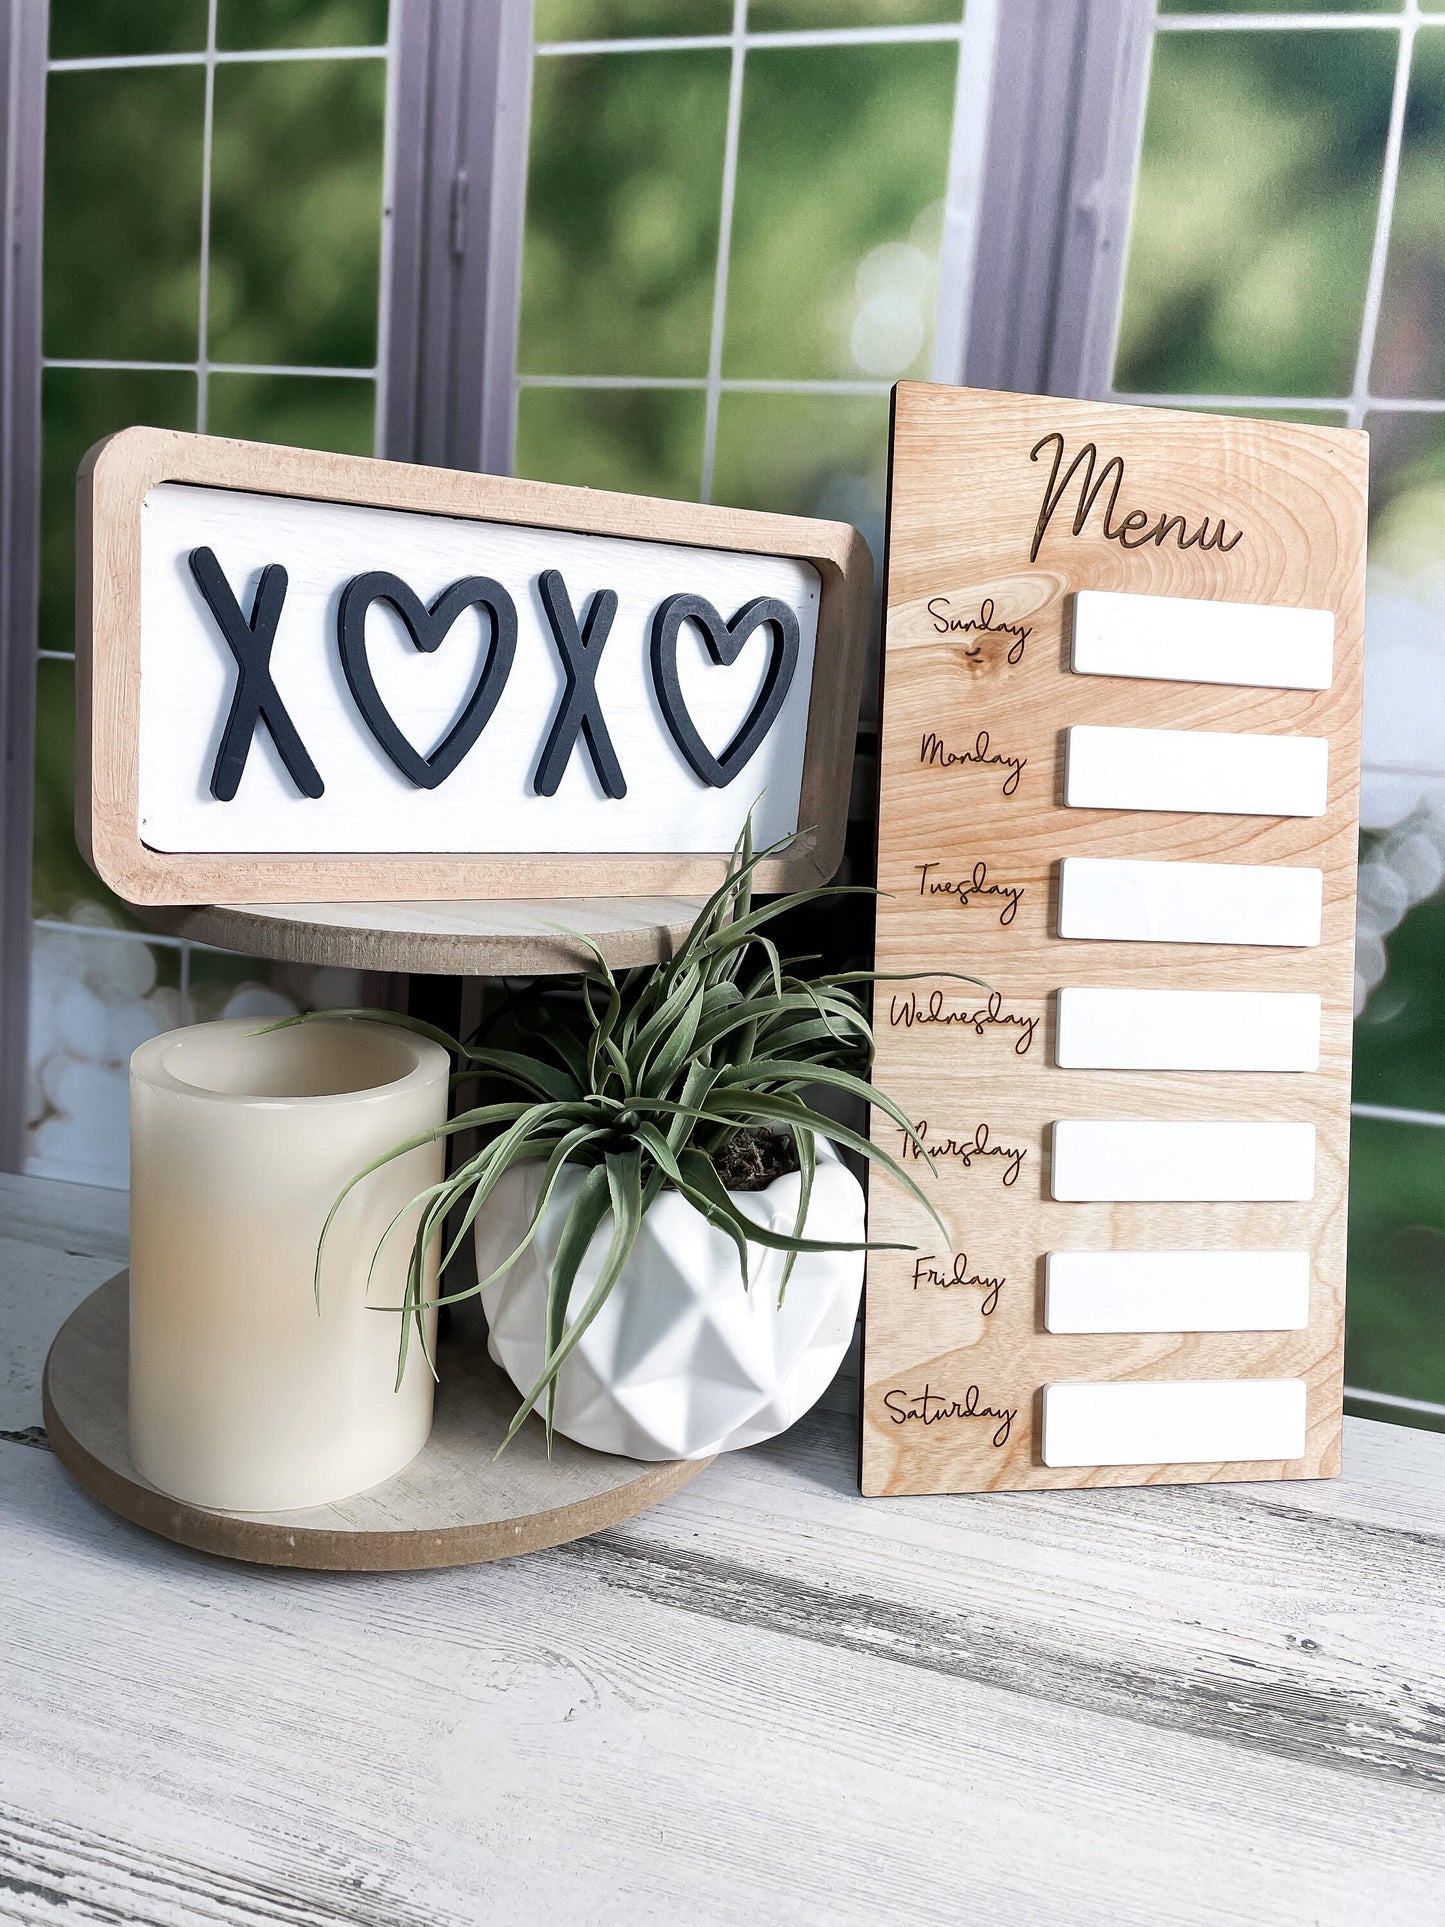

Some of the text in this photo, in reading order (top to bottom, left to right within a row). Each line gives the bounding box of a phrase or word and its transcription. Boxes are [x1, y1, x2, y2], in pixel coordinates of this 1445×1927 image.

[1030, 432, 1243, 563] Menu
[927, 597, 1032, 665] Sunday
[920, 731, 1027, 796] Monday
[914, 862, 1025, 925] Tuesday
[890, 991, 1040, 1054] Wednesday
[912, 1253, 1006, 1316] Friday
[883, 1384, 1018, 1447] Saturday
